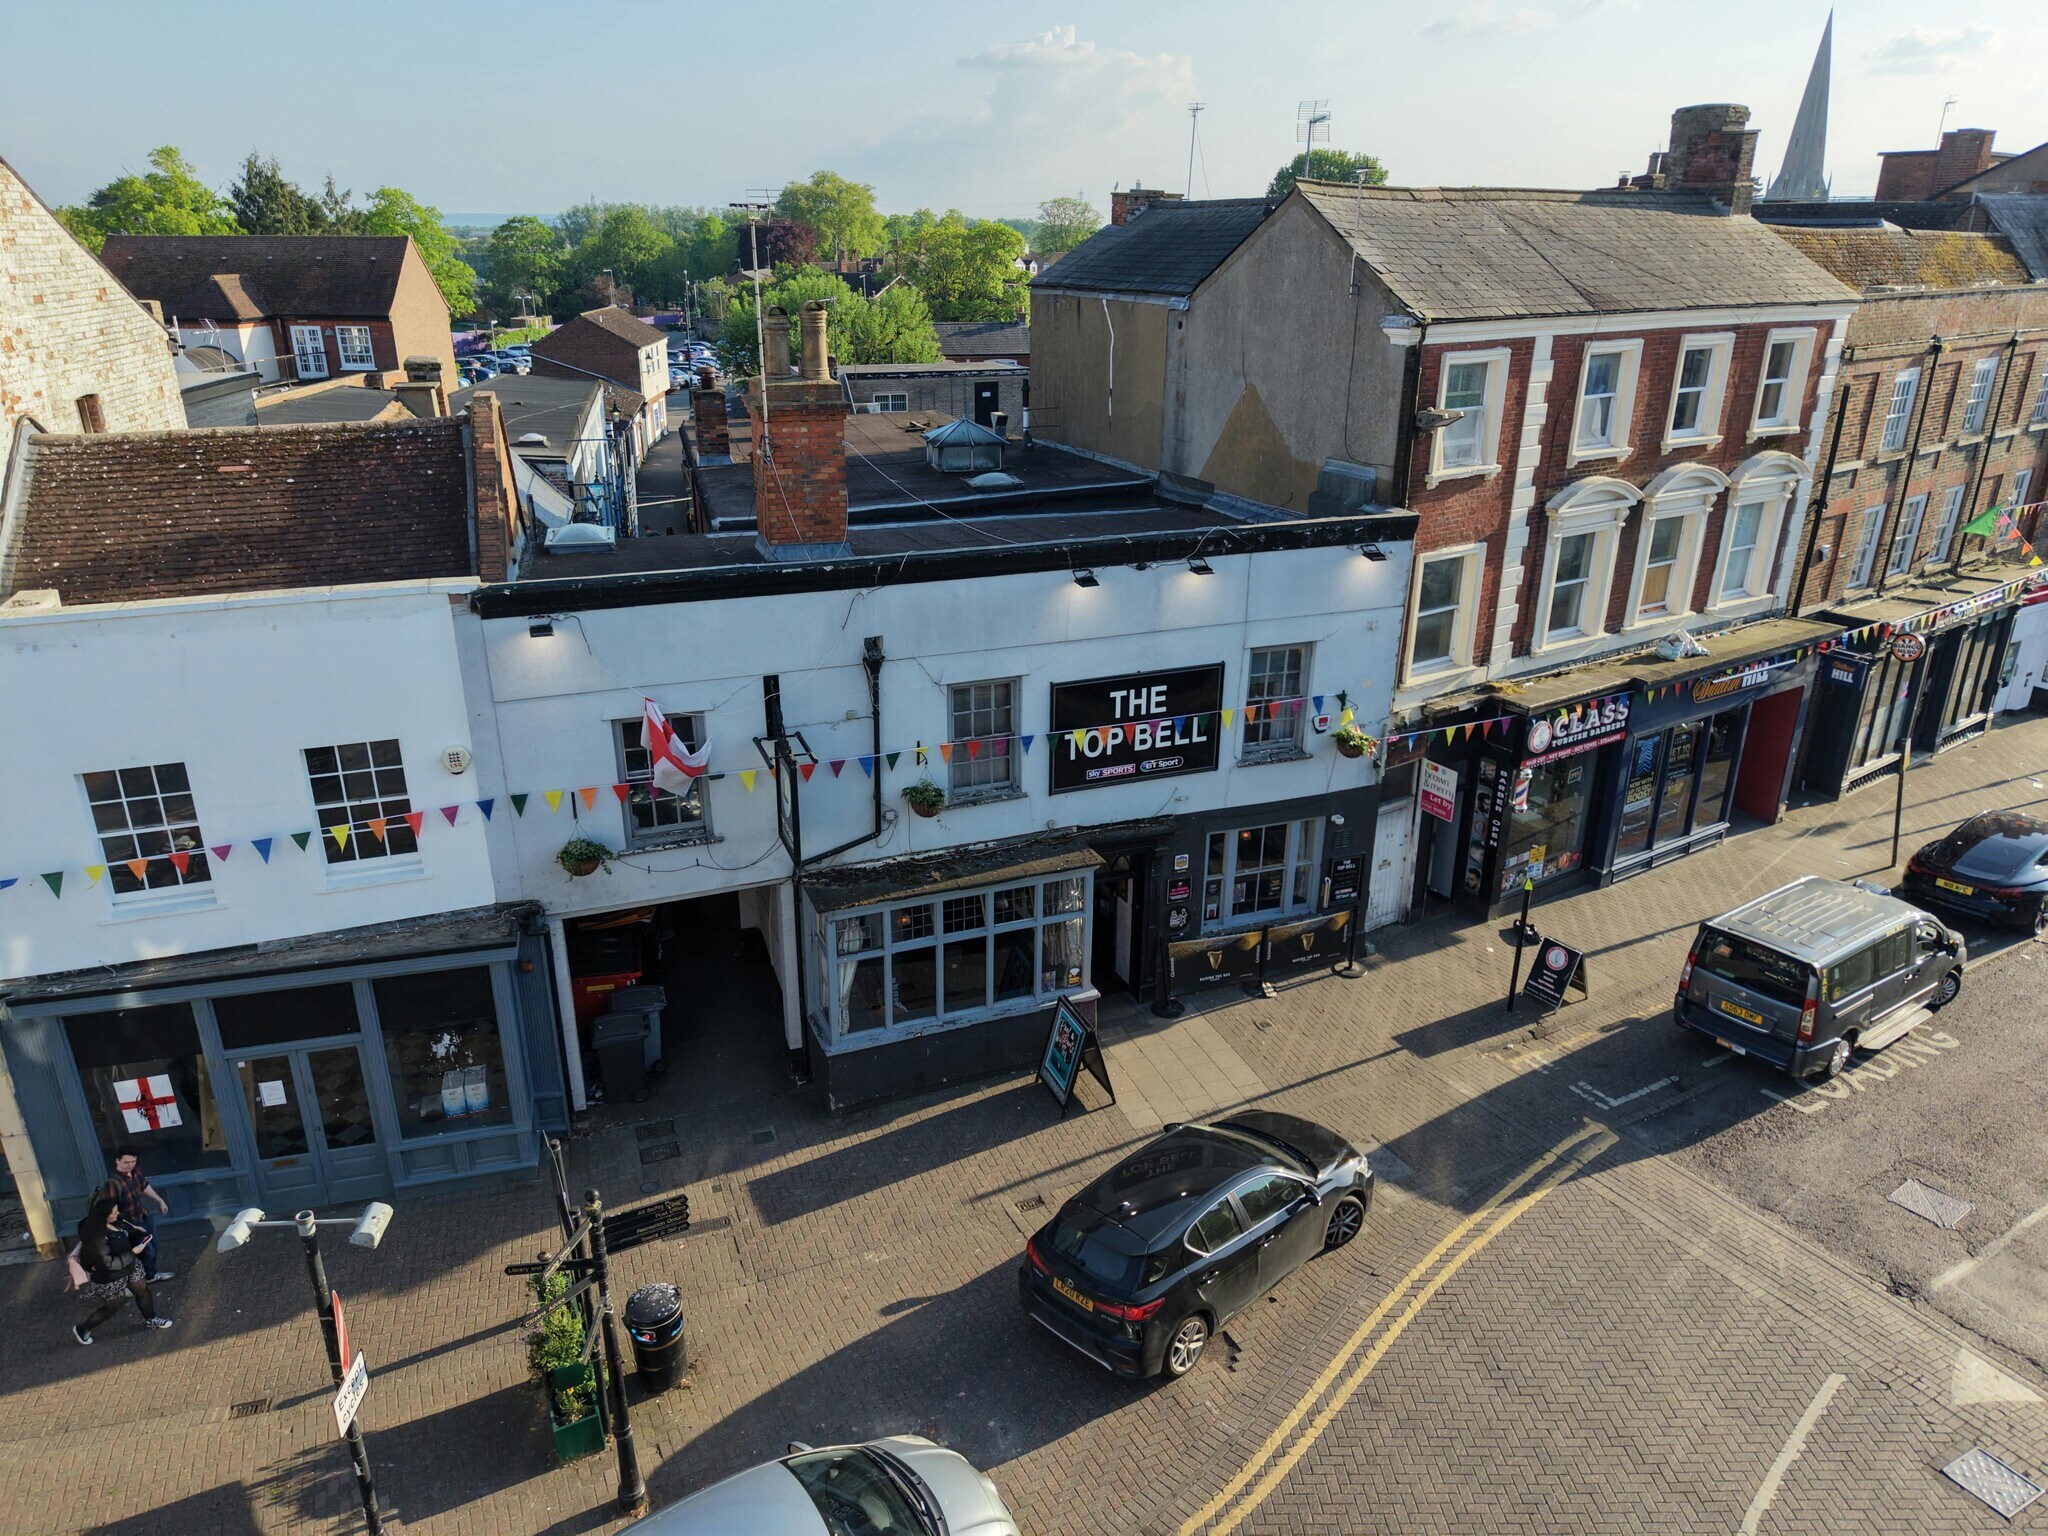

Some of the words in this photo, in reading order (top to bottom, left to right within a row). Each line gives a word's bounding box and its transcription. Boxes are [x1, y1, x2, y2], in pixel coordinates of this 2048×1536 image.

[1893, 642, 1922, 650] BIANCO
[1831, 668, 1853, 684] HILL
[1109, 684, 1168, 719] THE
[1553, 701, 1630, 738] CLASS
[1064, 727, 1124, 761] TOP
[1133, 716, 1208, 752] BELL
[1551, 730, 1588, 748] TURKISH
[1589, 720, 1627, 736] BARBERS
[1088, 770, 1101, 778] sky
[1101, 765, 1134, 776] SPORTS
[1145, 760, 1157, 769] BT
[1157, 758, 1179, 768] Sport
[1424, 768, 1450, 787] brown
[1430, 794, 1442, 805] Let
[1442, 797, 1453, 810] by
[1495, 770, 1508, 813] BARBER
[1626, 788, 1652, 803] BOOST
[1489, 820, 1501, 847] OPEN
[1760, 1024, 1960, 1115] LOADING
[636, 1221, 666, 1234] Recreation
[666, 1213, 688, 1224] Ground
[525, 1310, 547, 1327] Citizens
[548, 1297, 566, 1311] Advice
[338, 1362, 363, 1412] Except
[342, 1380, 364, 1424] cycles
